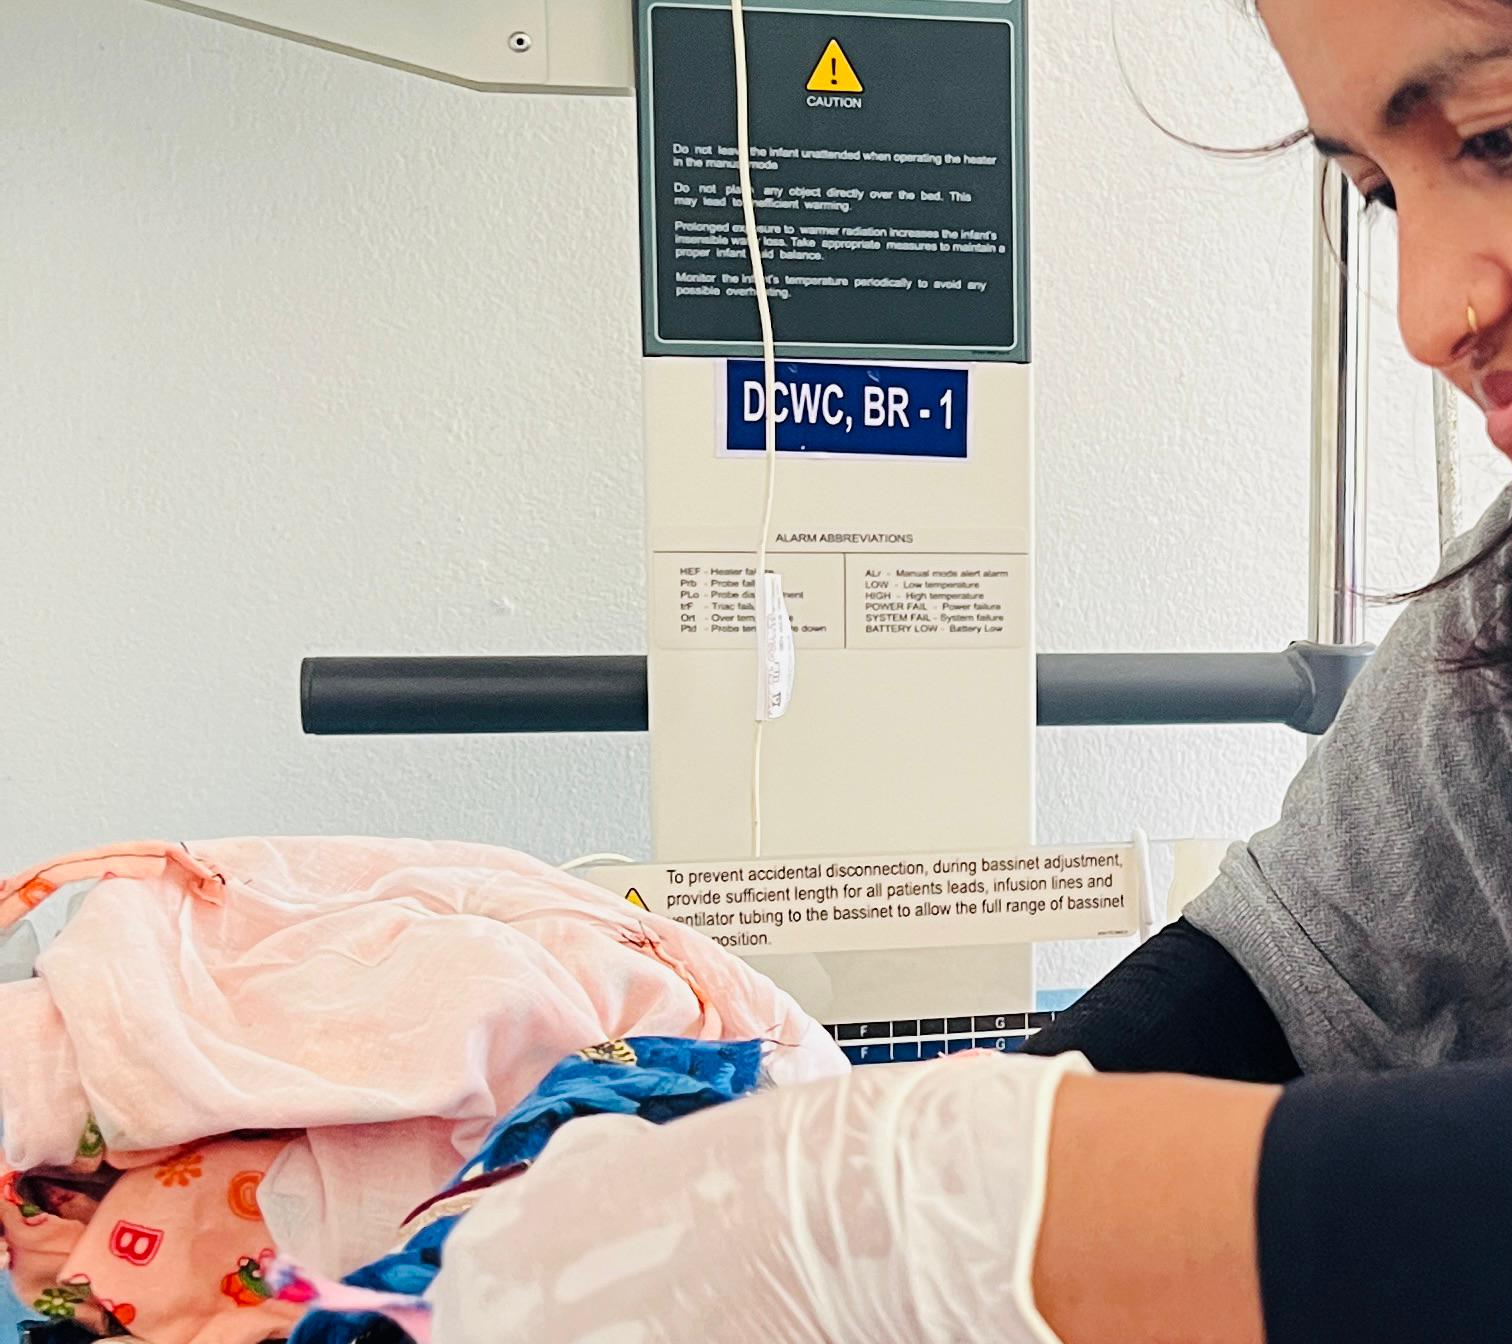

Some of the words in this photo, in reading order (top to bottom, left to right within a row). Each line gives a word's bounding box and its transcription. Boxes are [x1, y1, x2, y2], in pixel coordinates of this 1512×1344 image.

[807, 96, 861, 108] CAUTION
[744, 380, 852, 433] DCWC,
[865, 386, 909, 427] BR
[920, 409, 930, 418] -
[940, 390, 951, 429] 1
[776, 534, 817, 542] ALARM
[819, 534, 913, 543] ABBREVIATIONS
[666, 870, 683, 884] To
[689, 869, 744, 887] prevent
[748, 864, 821, 881] accidental
[933, 860, 976, 876] during
[982, 857, 1039, 871] bassinet
[667, 890, 720, 909] provide
[726, 888, 790, 903] sufficient
[795, 885, 838, 903] length
[843, 884, 862, 898] for
[867, 883, 882, 897] all
[887, 882, 942, 900] patients
[994, 877, 1046, 892] infusion
[1052, 876, 1083, 889] lines
[1088, 874, 1112, 888] and
